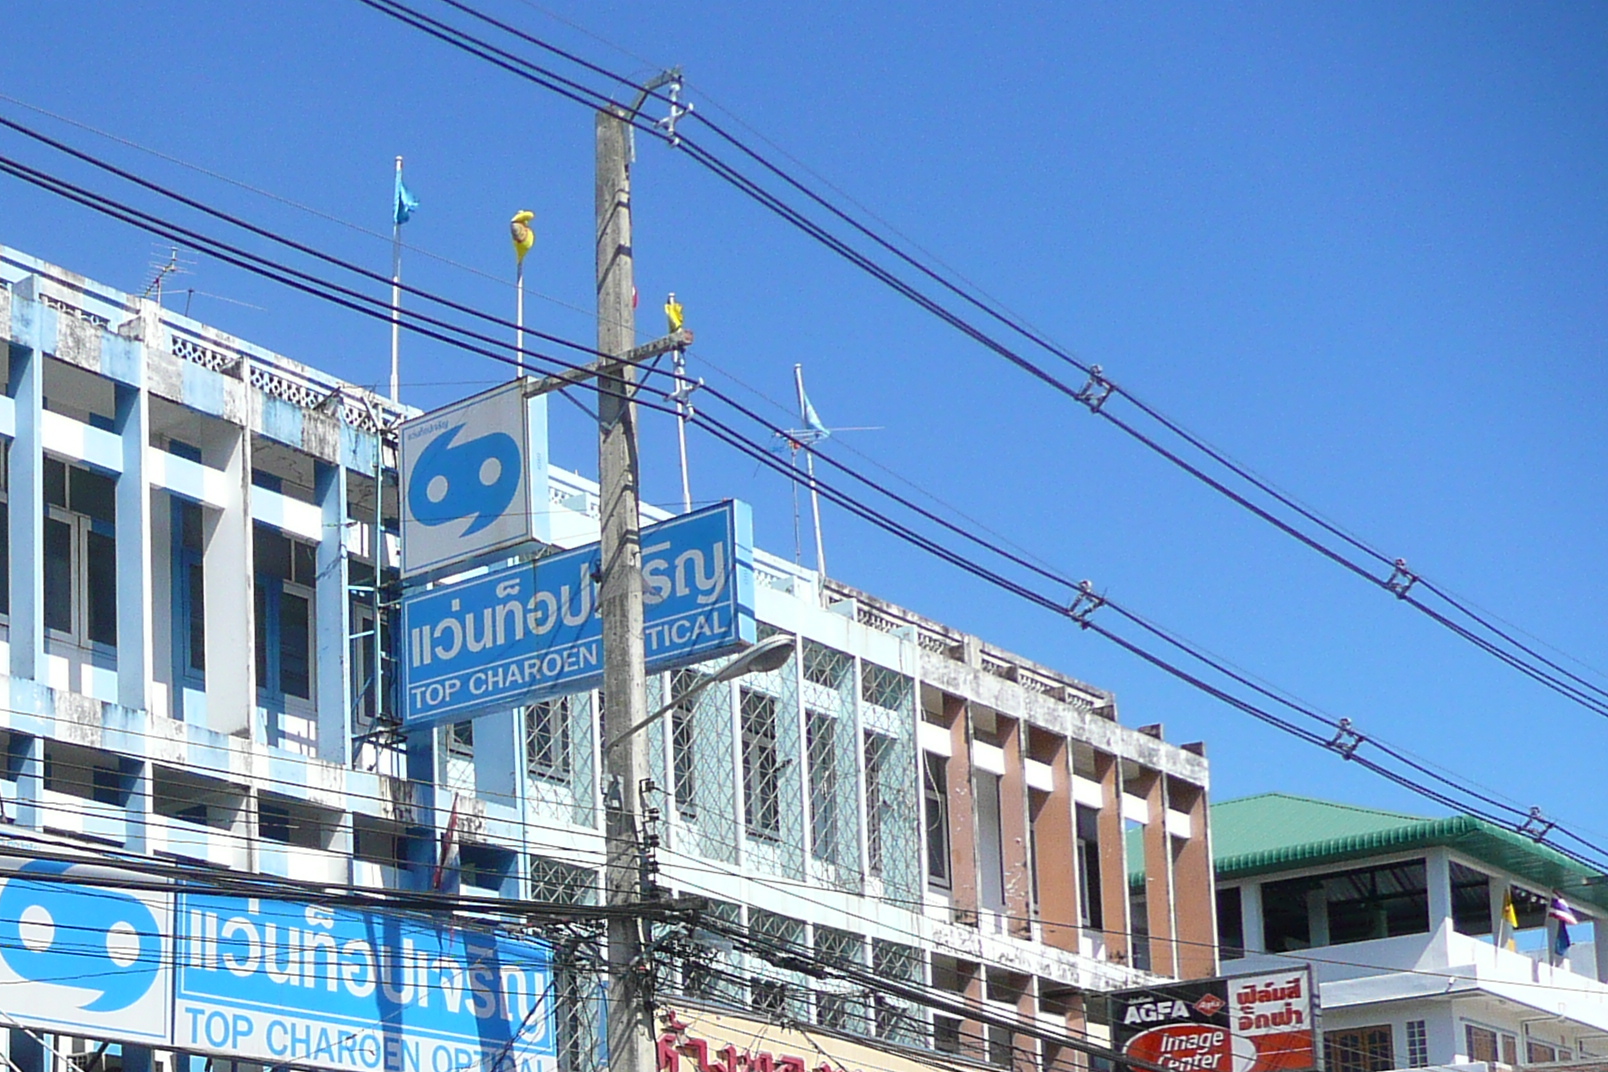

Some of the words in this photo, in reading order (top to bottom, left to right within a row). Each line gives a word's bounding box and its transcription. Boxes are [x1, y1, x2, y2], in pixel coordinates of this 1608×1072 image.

[411, 541, 725, 668] แว่นท็อปริญ
[410, 679, 462, 709] TOP
[468, 643, 599, 695] CHAROEN
[644, 611, 729, 650] TICAL
[189, 893, 547, 1044] แว่นท็อปเจริญ
[1236, 977, 1302, 1005] ฟิล์มสี
[184, 1006, 253, 1050] TOP
[1123, 1000, 1190, 1024] AGFA
